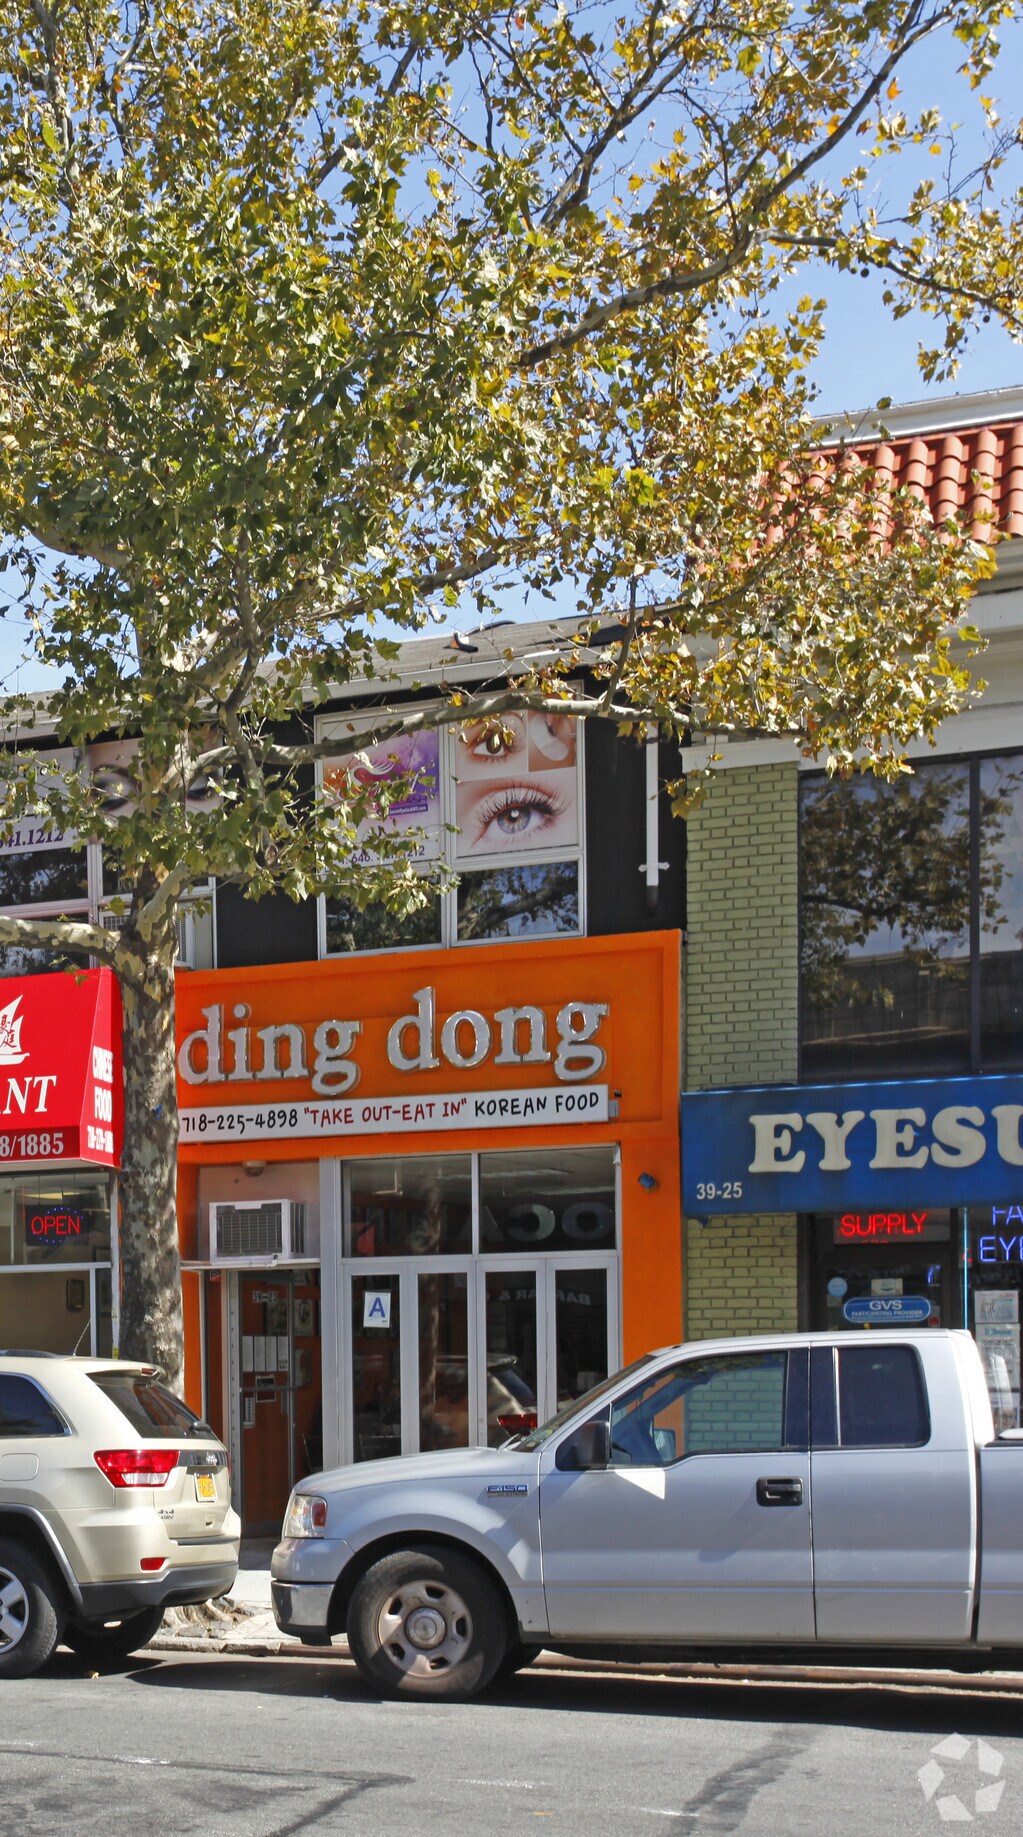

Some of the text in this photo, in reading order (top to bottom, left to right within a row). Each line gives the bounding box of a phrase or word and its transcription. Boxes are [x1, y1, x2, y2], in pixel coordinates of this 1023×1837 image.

[177, 986, 609, 1096] ding dong
[94, 1086, 112, 1122] FOOD
[182, 1109, 298, 1133] 718-225-4898
[361, 1103, 435, 1122] OUT-EAT
[474, 1097, 547, 1118] KOREAN
[555, 1092, 599, 1113] FOOD
[696, 1182, 742, 1200] 39-25
[31, 1215, 81, 1235] OPEN
[840, 1212, 928, 1238] SUPPLY
[979, 1236, 1023, 1262] EY
[368, 1296, 386, 1318] A
[869, 1299, 902, 1310] GVS
